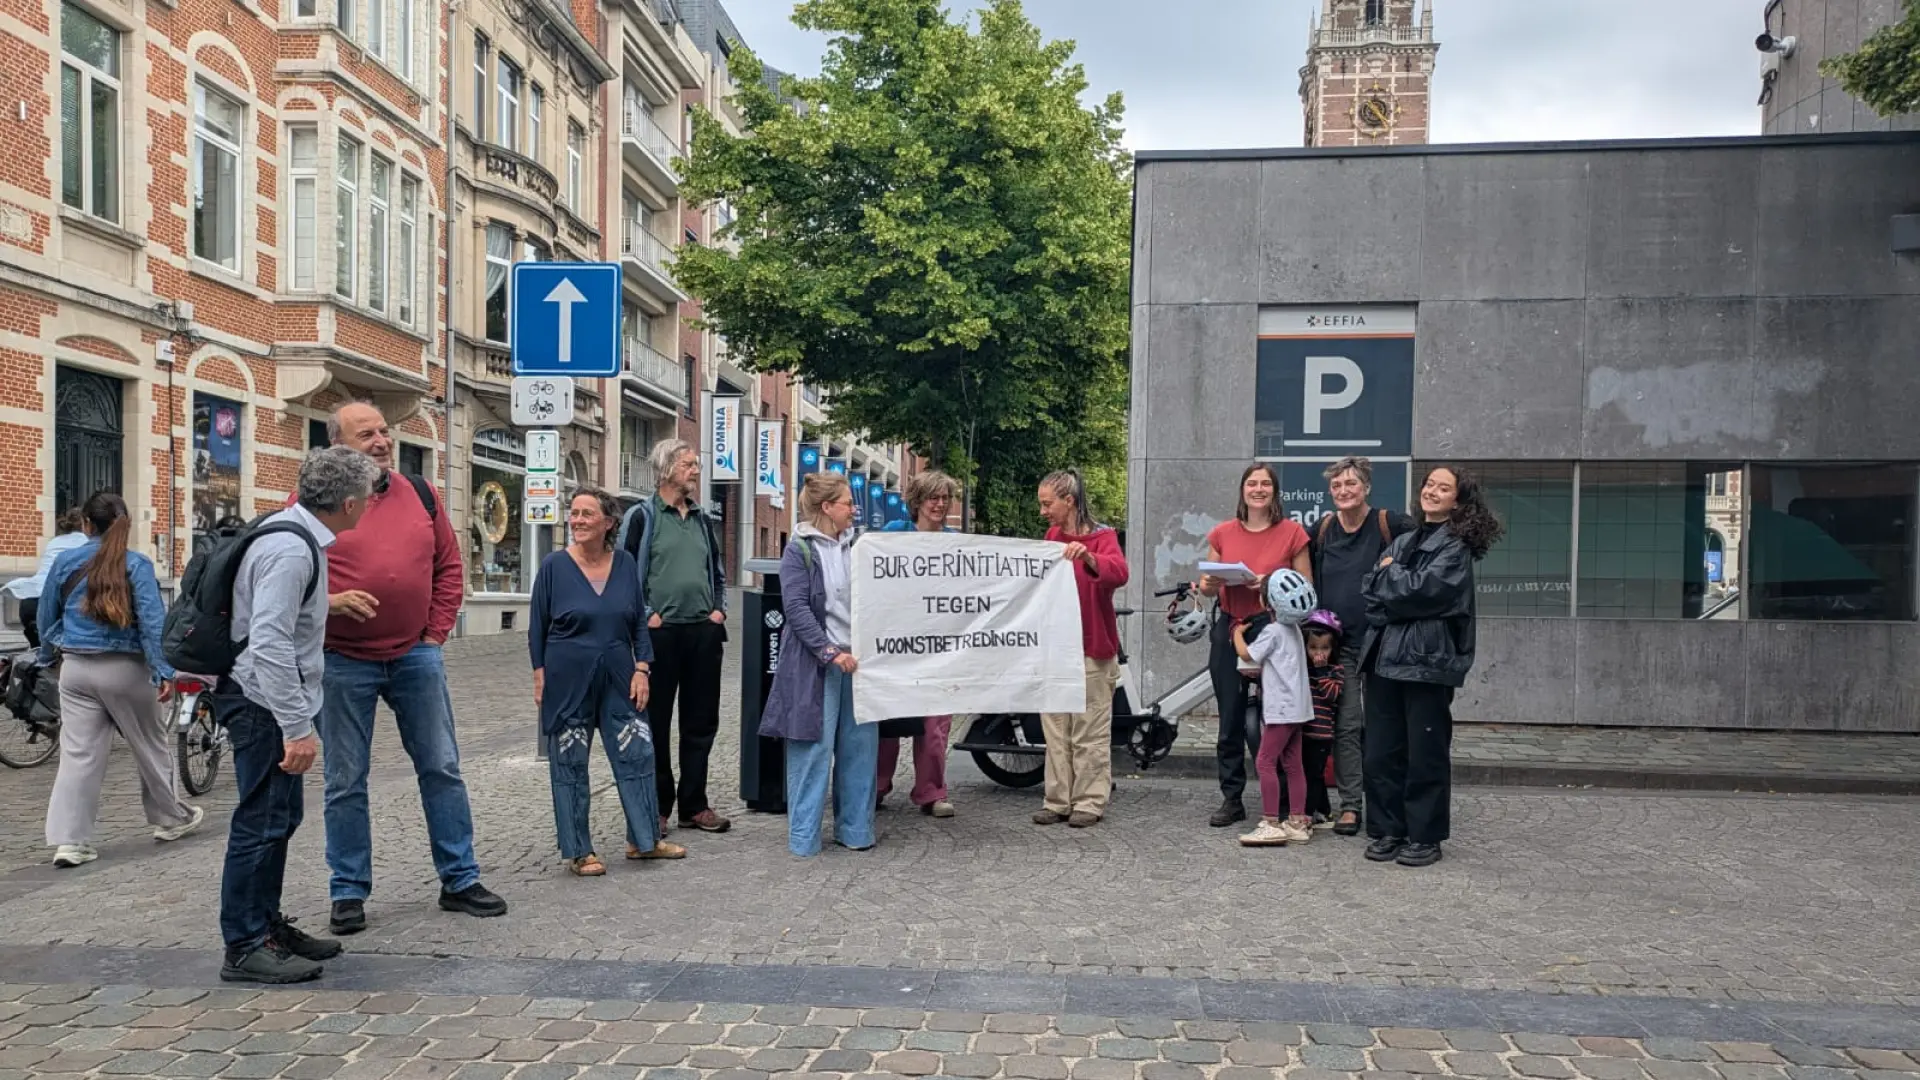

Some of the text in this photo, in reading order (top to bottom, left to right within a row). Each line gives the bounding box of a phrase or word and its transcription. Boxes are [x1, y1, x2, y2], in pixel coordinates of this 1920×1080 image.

[1324, 315, 1366, 326] EFFIA
[1303, 356, 1364, 434] P
[716, 407, 725, 452] OMNIA
[760, 430, 768, 470] OMNIA
[872, 549, 1053, 580] BURGERINITIATIEF
[922, 596, 991, 614] TEGEN
[767, 633, 778, 673] leuven
[875, 629, 1039, 654] WOONSTBETREDINGEN
